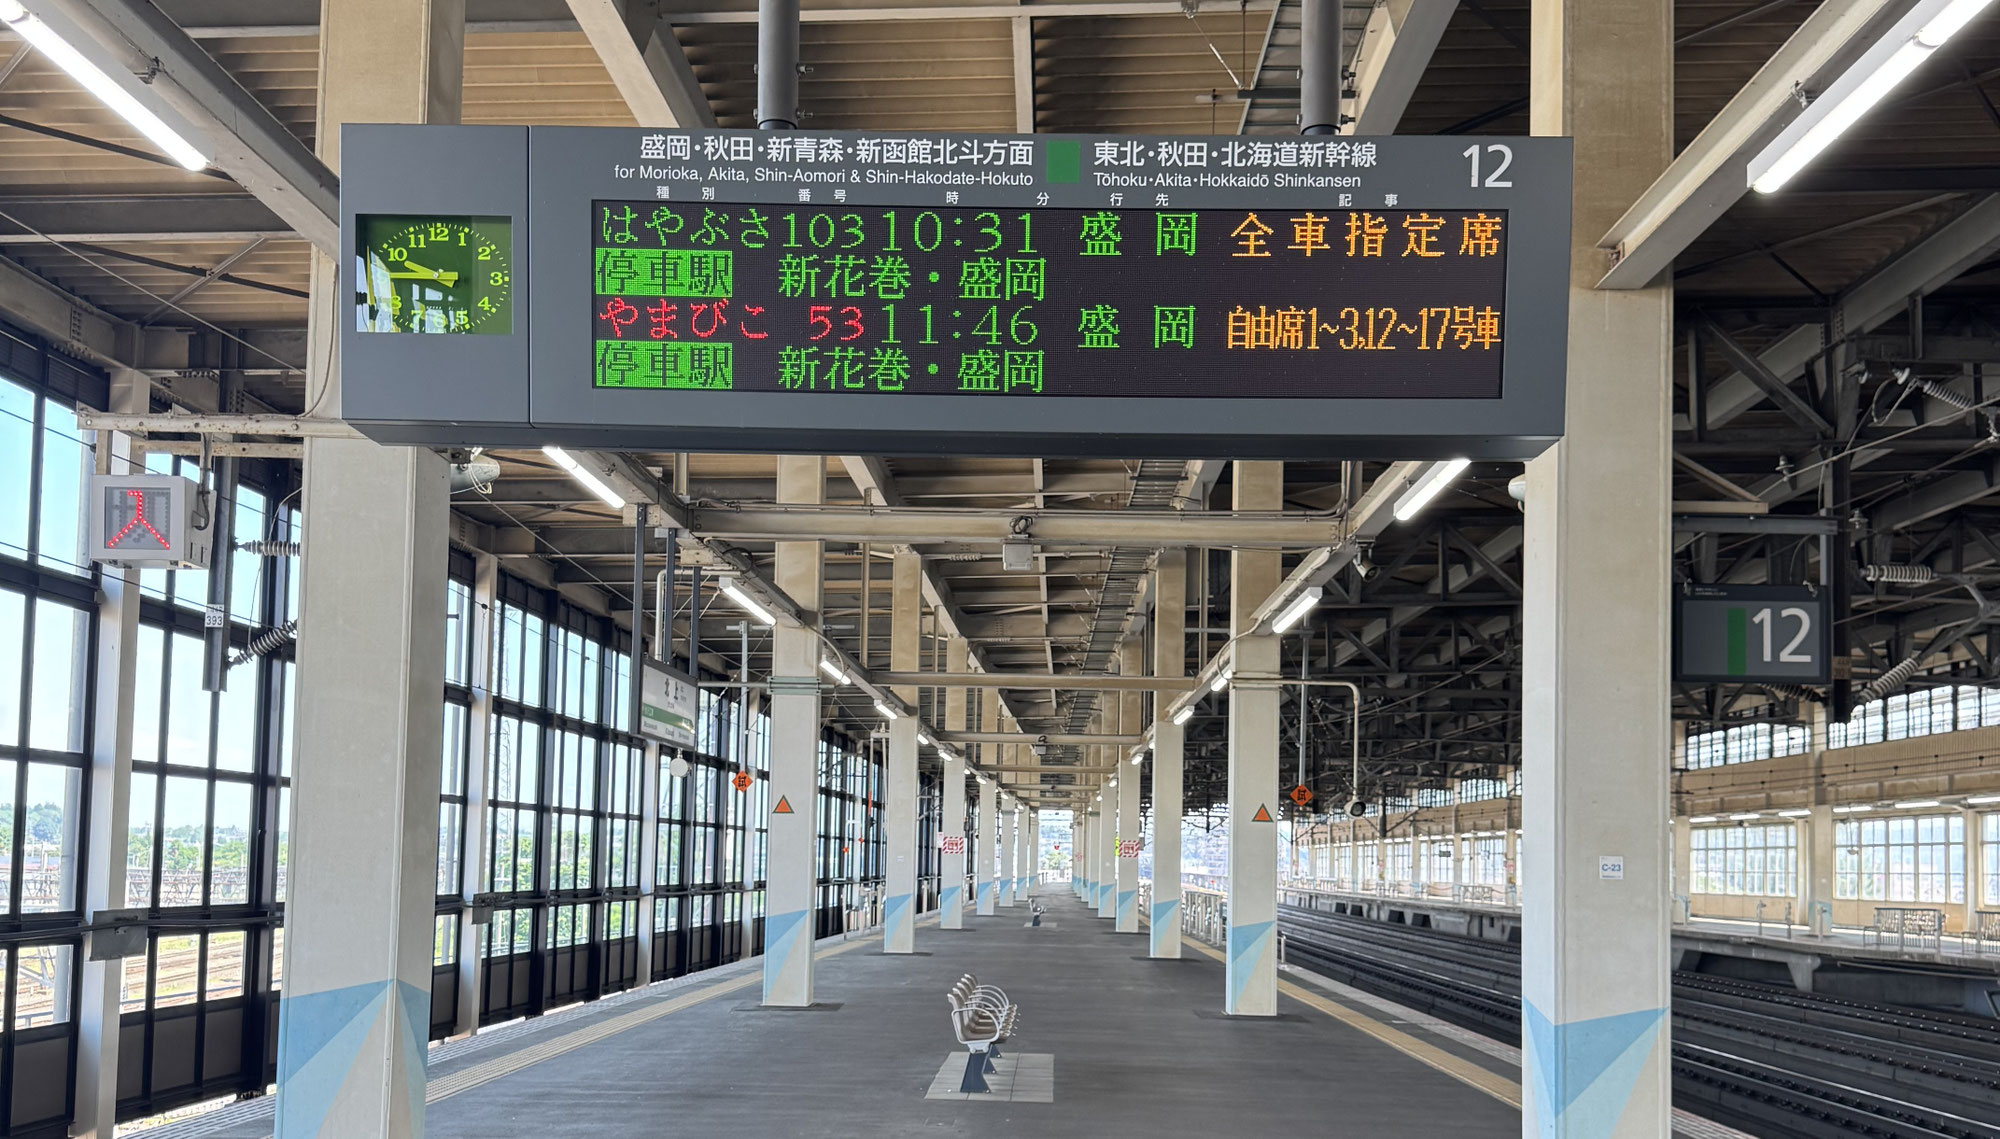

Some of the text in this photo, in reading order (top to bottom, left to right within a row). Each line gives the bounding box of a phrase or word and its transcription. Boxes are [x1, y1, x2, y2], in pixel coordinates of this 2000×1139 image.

[640, 134, 1034, 166] 盛岡・秋田・新青森・新函館北斗方面
[1093, 141, 1378, 168] 東北・秋田・北海道新幹線
[1462, 144, 1513, 189] 12
[614, 165, 1034, 187] for Morioka, Akita, Shin-Aomori & Shin-Hakodate-Hokuto
[1274, 173, 1361, 188] Shinkansen
[946, 190, 960, 205] 時
[1036, 192, 1050, 206] 分
[428, 227, 449, 242] 12
[603, 205, 1502, 257] はやぶさ 103 10:31 盛岡 全車指定席
[408, 234, 427, 248] 11
[458, 232, 467, 246] 1
[388, 247, 408, 262] 10
[477, 246, 491, 260] 2
[489, 271, 503, 286] 3
[597, 250, 1046, 301] 停車駅 新花巻・盛岡
[390, 295, 402, 310] 8
[477, 296, 491, 311] 4
[411, 310, 423, 324] 7
[455, 310, 469, 325] 5
[600, 297, 769, 340] やまびこ
[808, 305, 865, 341] 53
[881, 304, 1038, 345] 11:46
[1078, 304, 1196, 349] 盛岡
[597, 342, 1045, 393] 停車駅 新花巻・盛岡
[206, 615, 223, 626] 393
[1752, 607, 1812, 663] 12
[1601, 863, 1622, 872] C-23
